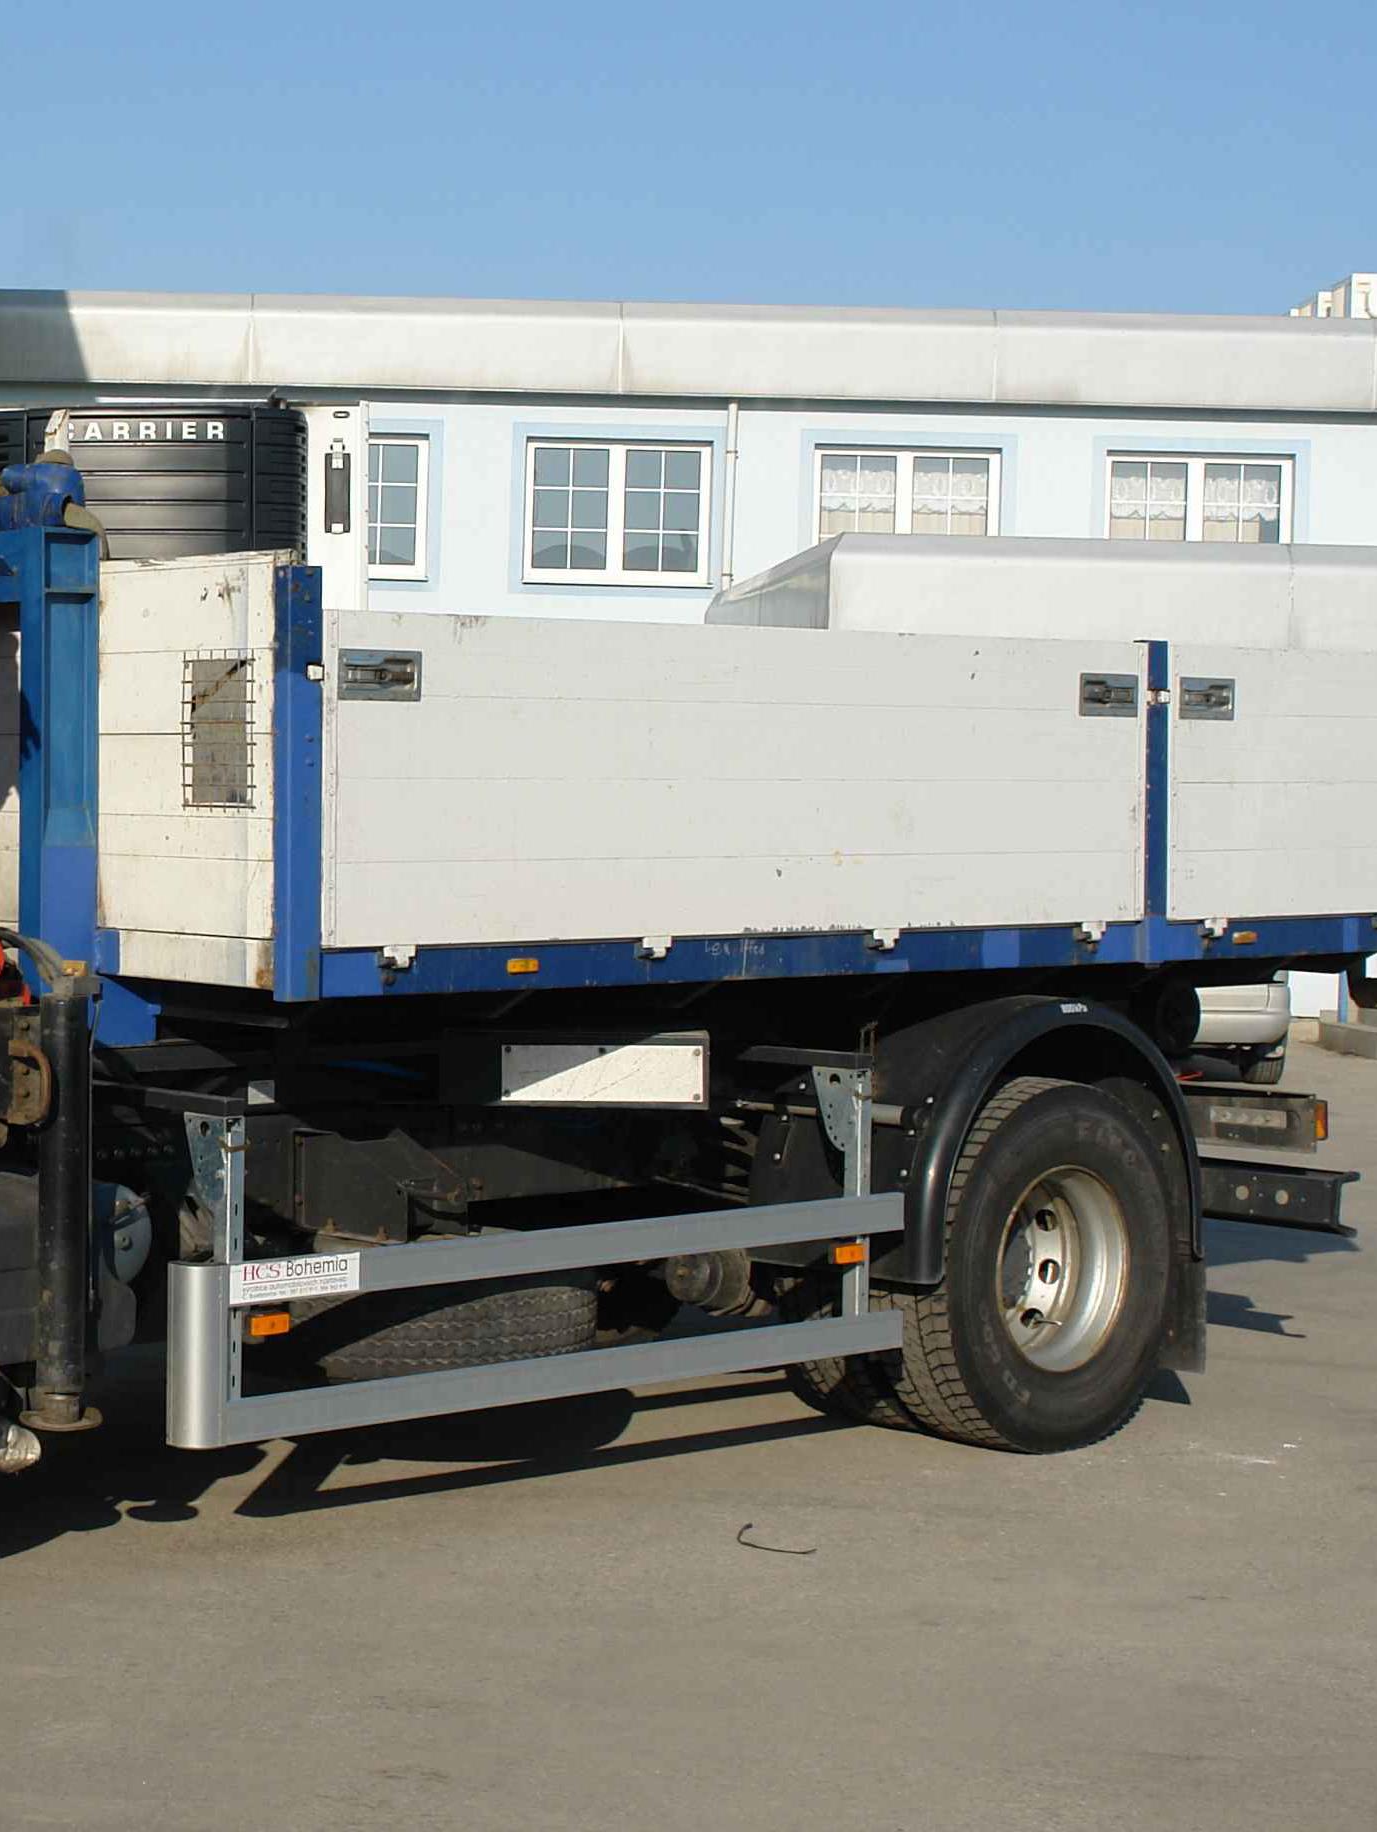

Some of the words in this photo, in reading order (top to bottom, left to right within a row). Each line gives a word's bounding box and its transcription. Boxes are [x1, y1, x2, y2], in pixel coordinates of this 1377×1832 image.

[68, 420, 224, 440] ARRIER
[242, 1262, 282, 1281] HCS
[286, 1256, 349, 1277] Bohemia
